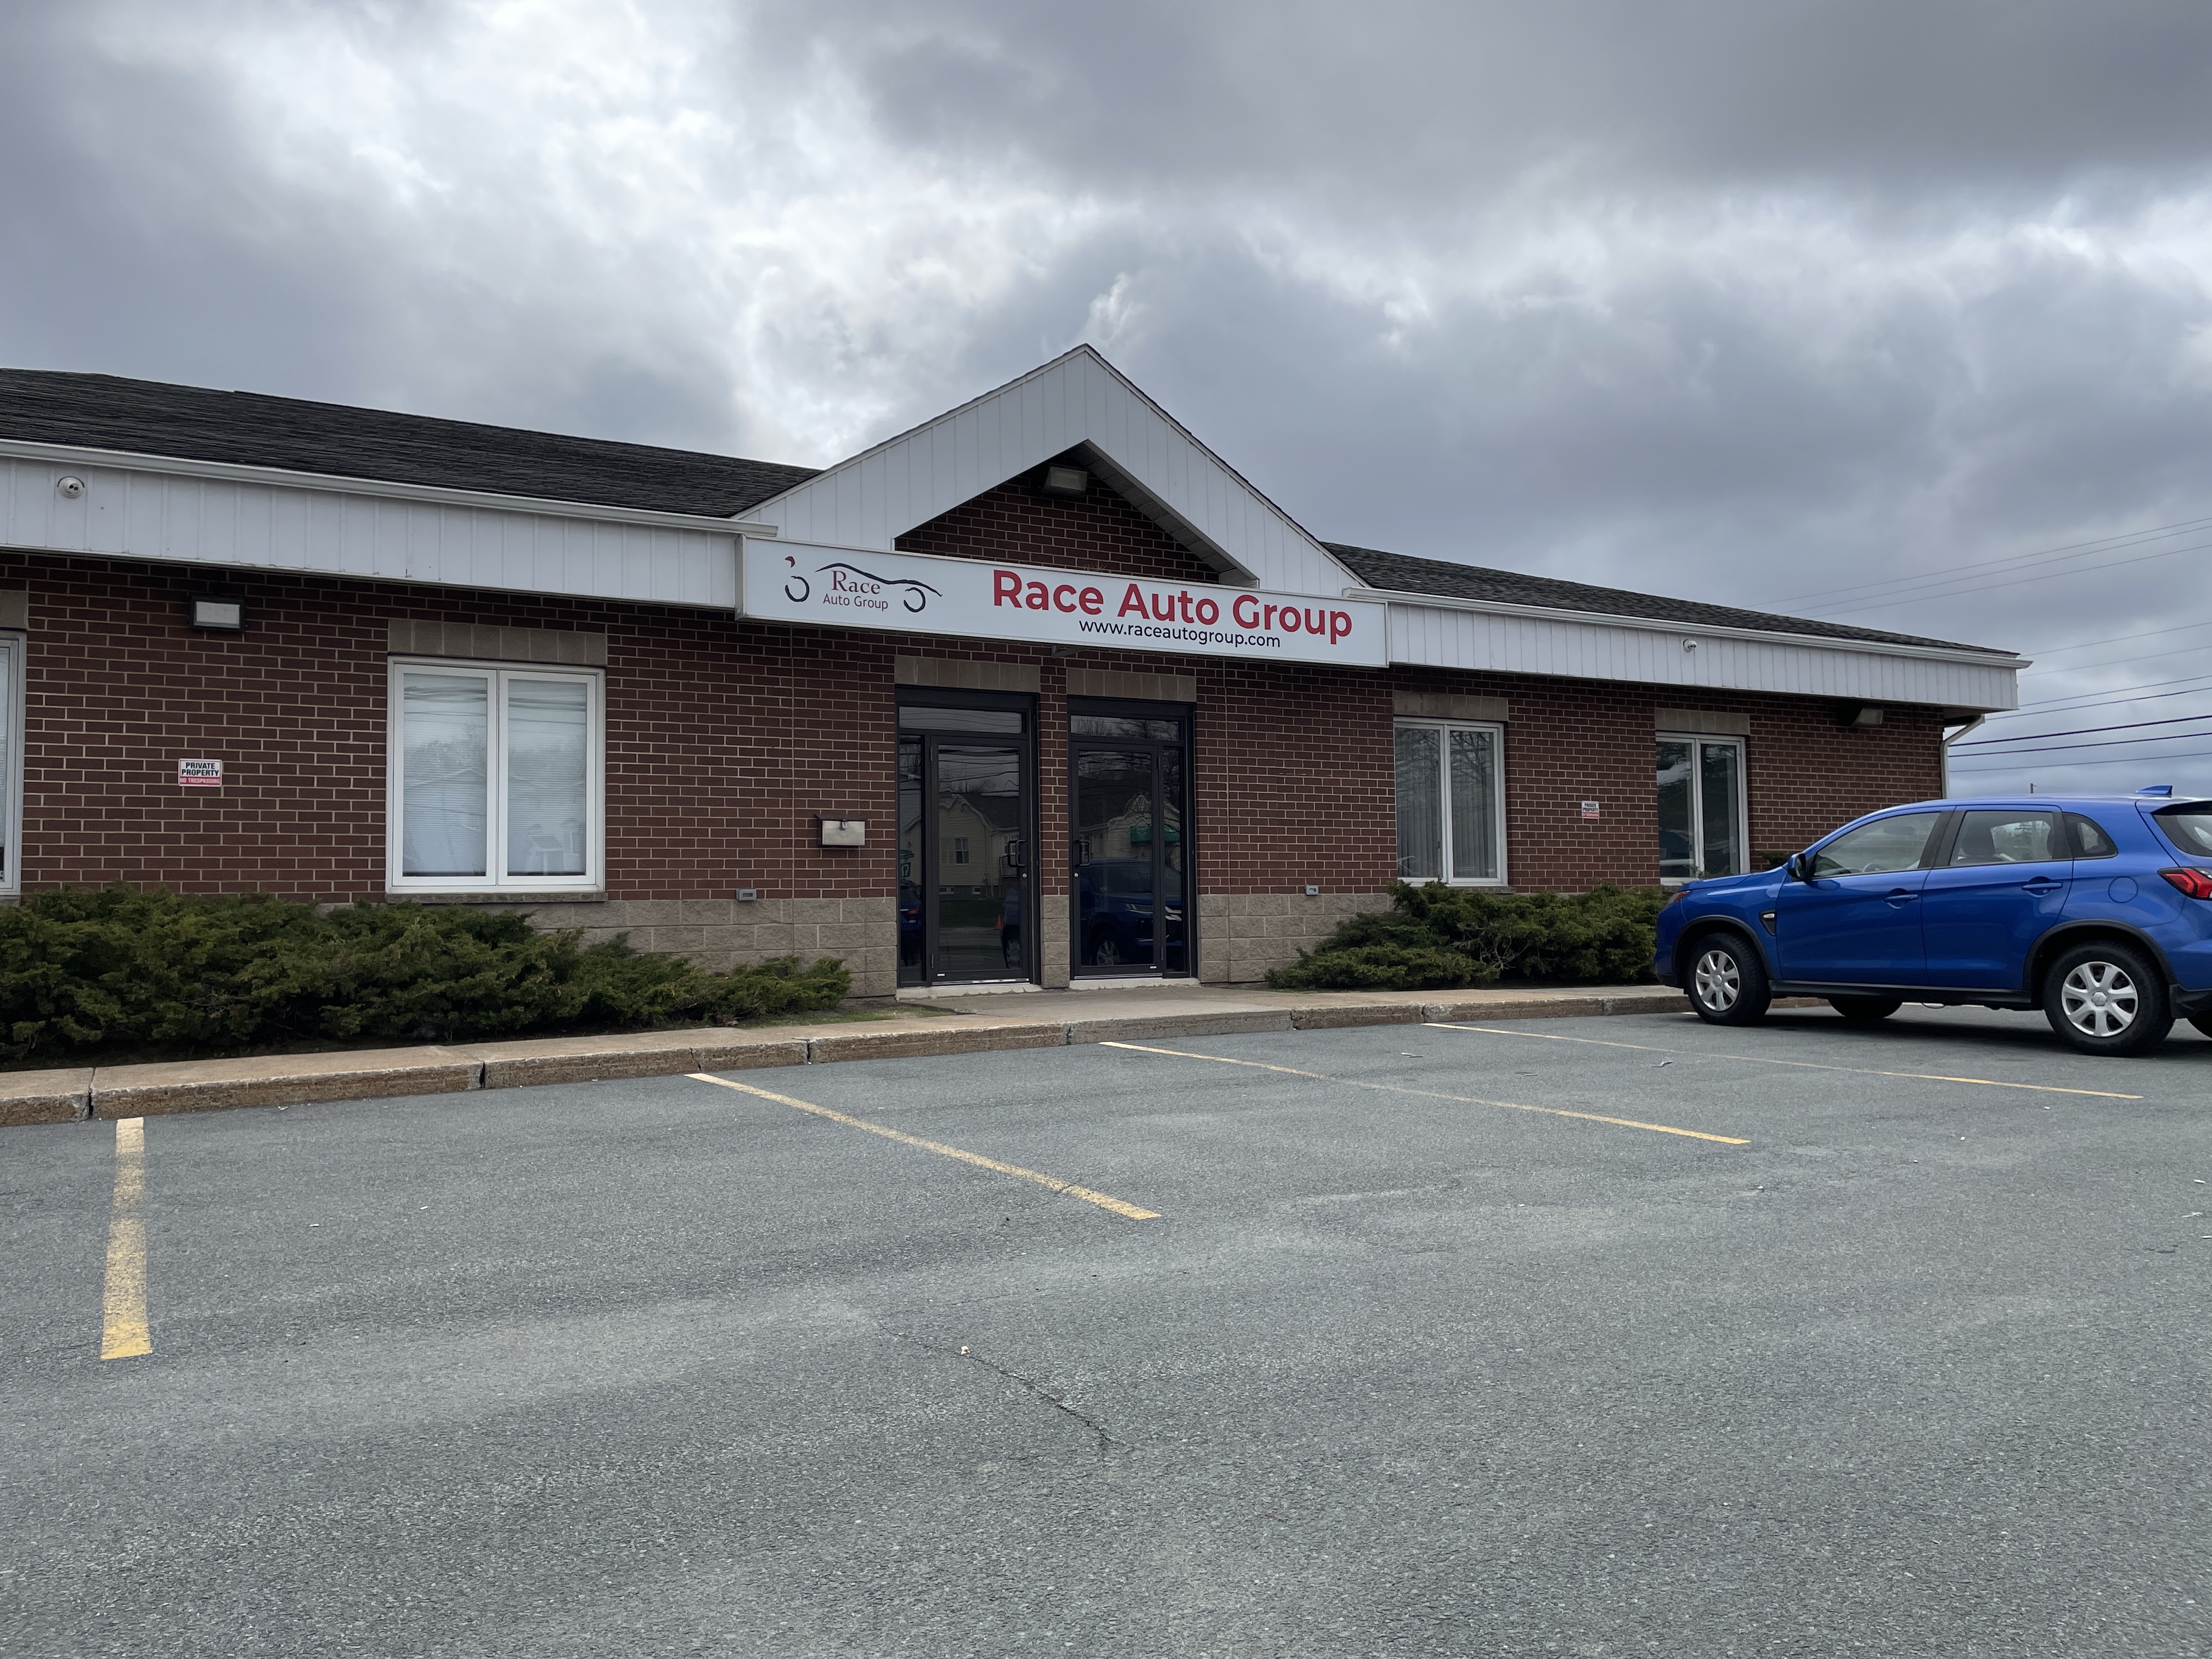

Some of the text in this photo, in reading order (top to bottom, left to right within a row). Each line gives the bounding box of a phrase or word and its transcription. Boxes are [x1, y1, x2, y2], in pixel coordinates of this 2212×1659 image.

[830, 569, 881, 595] Race
[822, 593, 889, 612] Auto Group
[993, 569, 1353, 645] Race Auto Group
[1079, 620, 1280, 648] www.raceautogroup.com
